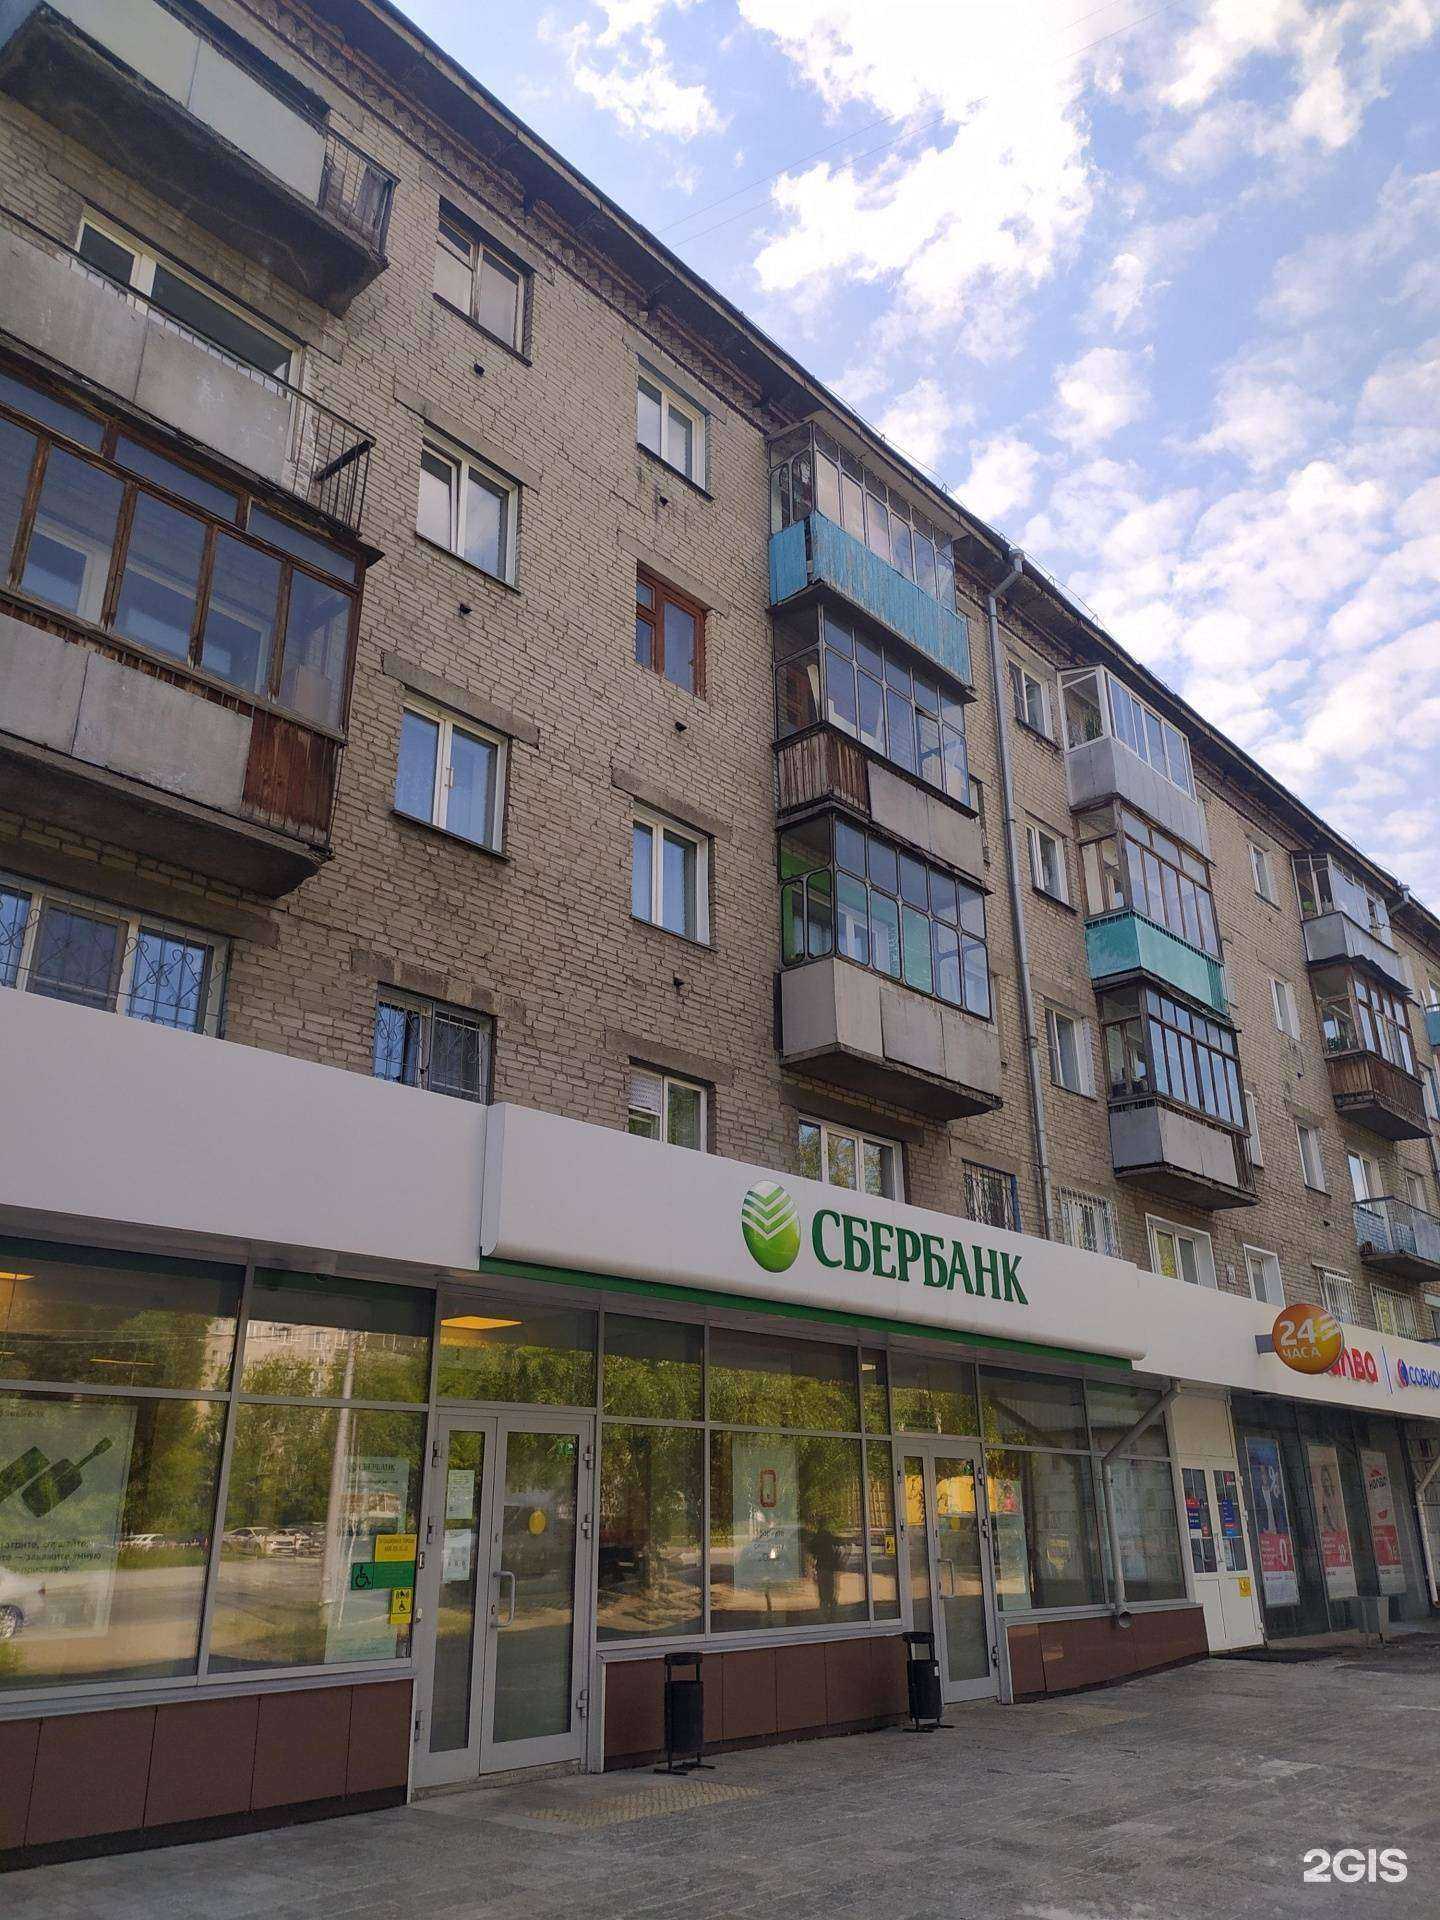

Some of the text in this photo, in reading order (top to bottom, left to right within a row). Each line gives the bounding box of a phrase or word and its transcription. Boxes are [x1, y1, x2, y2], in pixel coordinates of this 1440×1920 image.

[811, 1209, 1029, 1305] СБЕРБАНК
[1279, 1318, 1316, 1346] 24
[1283, 1347, 1321, 1359] ЧАСА
